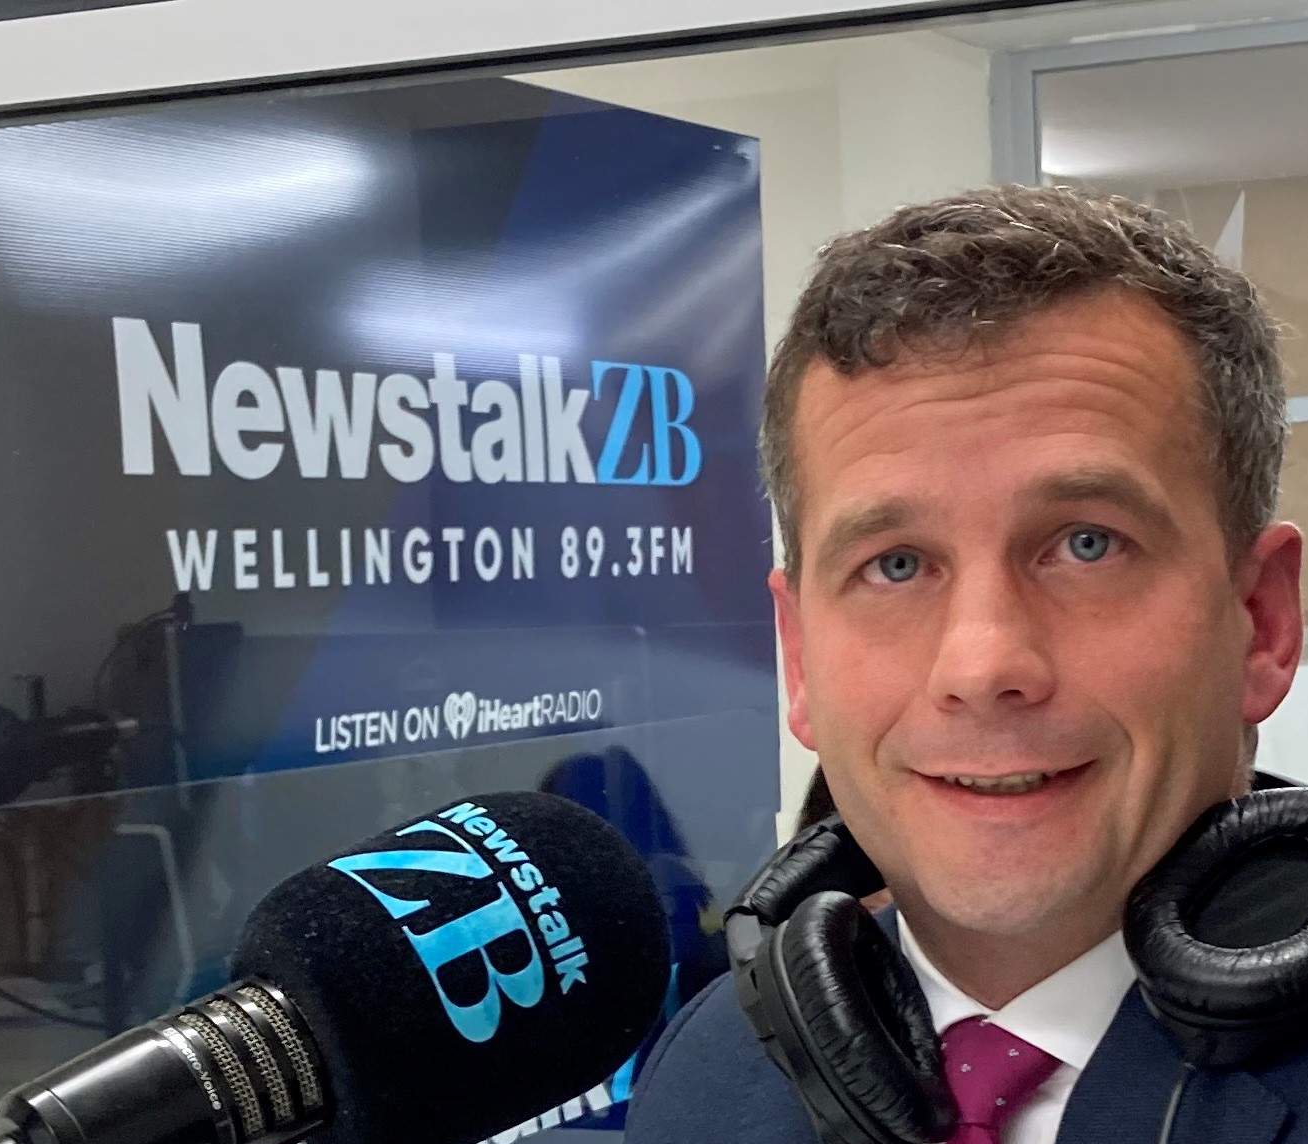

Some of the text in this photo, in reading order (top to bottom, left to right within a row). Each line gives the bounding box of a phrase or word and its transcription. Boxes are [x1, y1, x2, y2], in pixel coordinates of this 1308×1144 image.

[167, 526, 693, 592] WELLINGTON 89.3FM
[315, 688, 603, 753] LISTEN ON iHeartRADIO
[327, 820, 545, 1043] ZB
[437, 802, 589, 995] Newstalk
[168, 1030, 222, 1111] ectro-Voice
